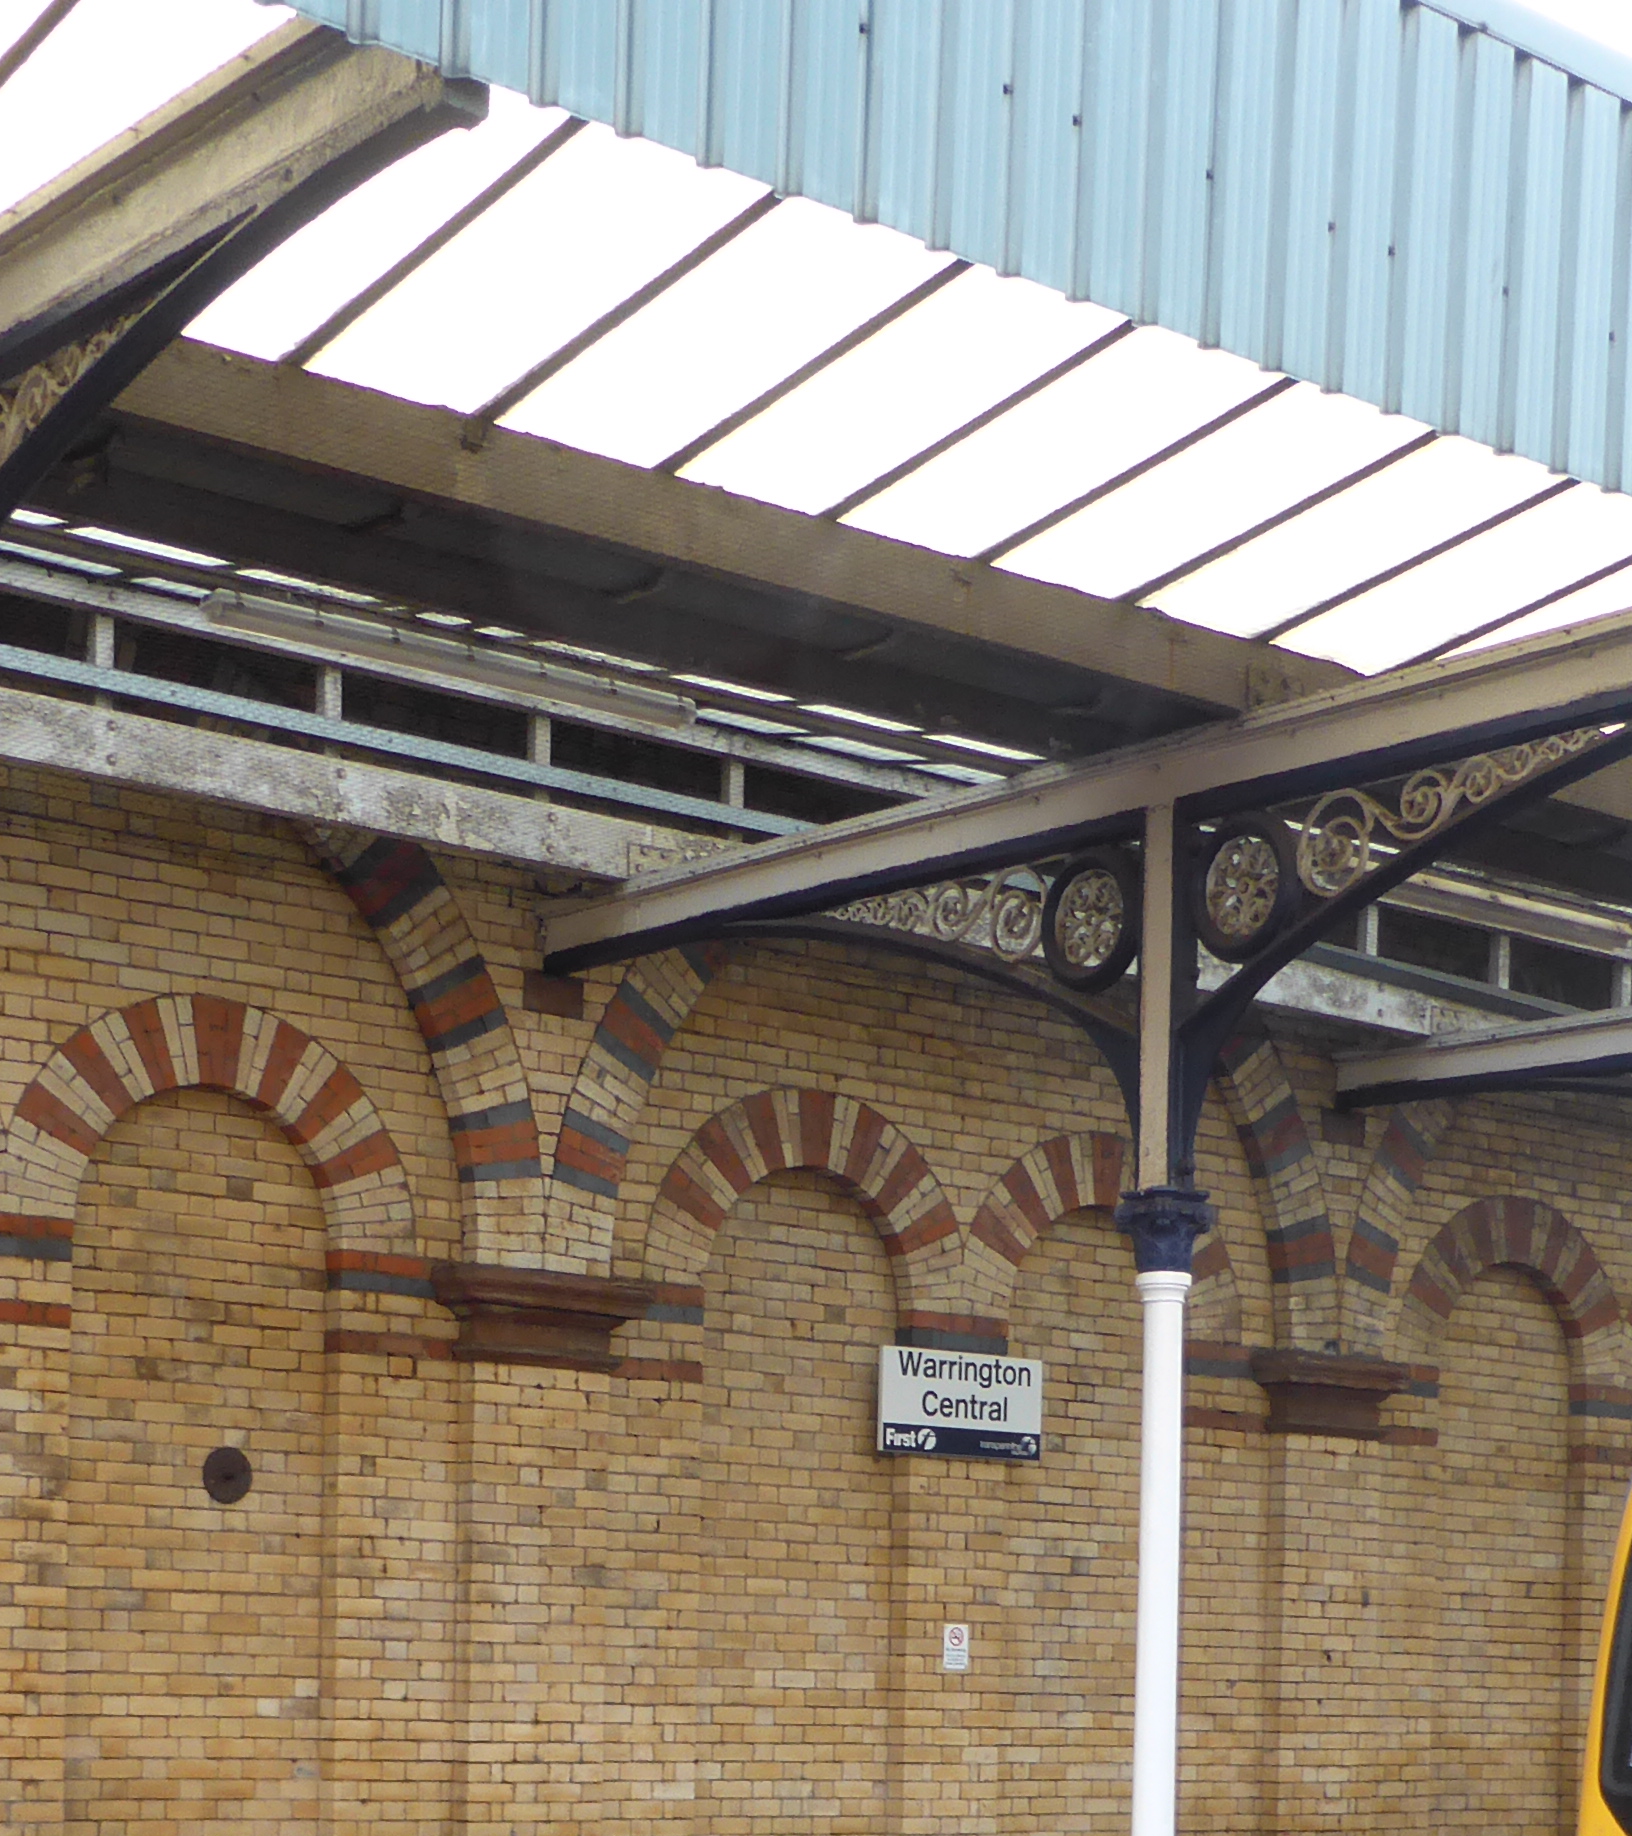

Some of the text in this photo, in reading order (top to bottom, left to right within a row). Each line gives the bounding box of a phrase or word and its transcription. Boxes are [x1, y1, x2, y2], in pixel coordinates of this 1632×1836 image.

[898, 1350, 1031, 1388] Warrington
[922, 1390, 1008, 1422] Central
[885, 1427, 917, 1448] First
